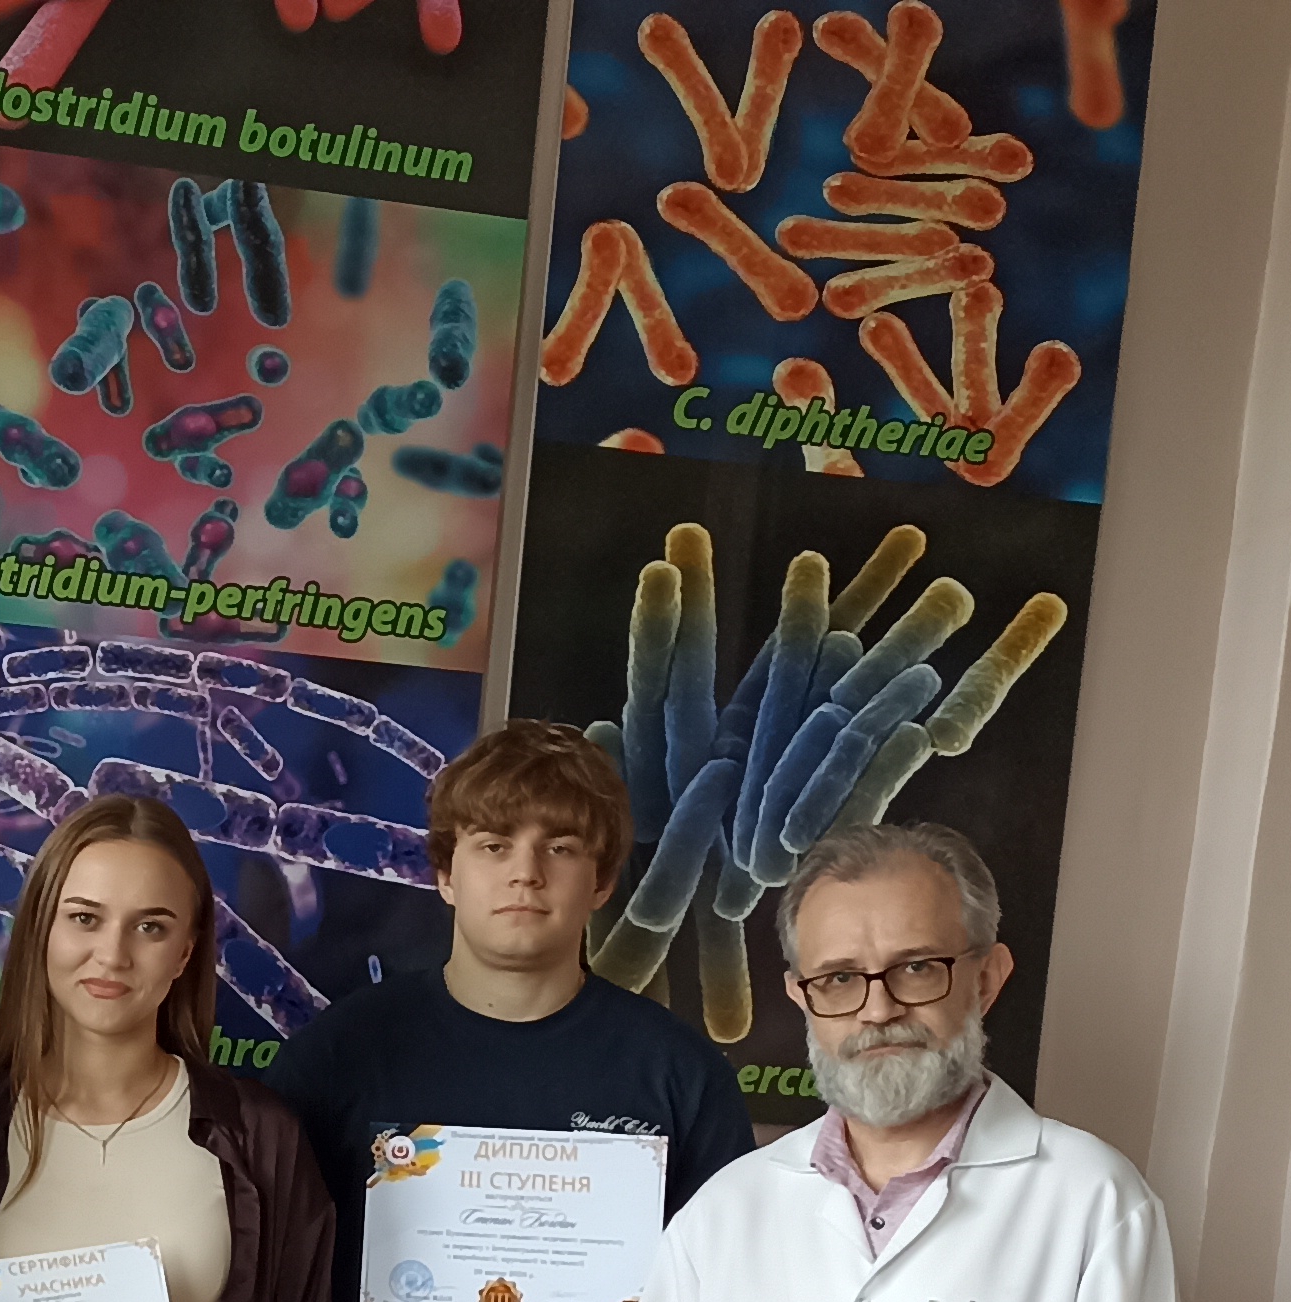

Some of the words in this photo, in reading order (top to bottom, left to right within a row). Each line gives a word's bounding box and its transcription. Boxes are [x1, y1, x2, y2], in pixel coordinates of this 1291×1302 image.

[239, 108, 474, 183] botulinum
[673, 386, 713, 430] C.
[726, 392, 992, 462] diphtheriae
[474, 1140, 579, 1162] ДИПЛОМ
[490, 1171, 592, 1194] СТУПЕНЯ
[8, 1249, 107, 1277] СЕРТИФІКАТ
[18, 1273, 106, 1298] УЧАСНИКА
